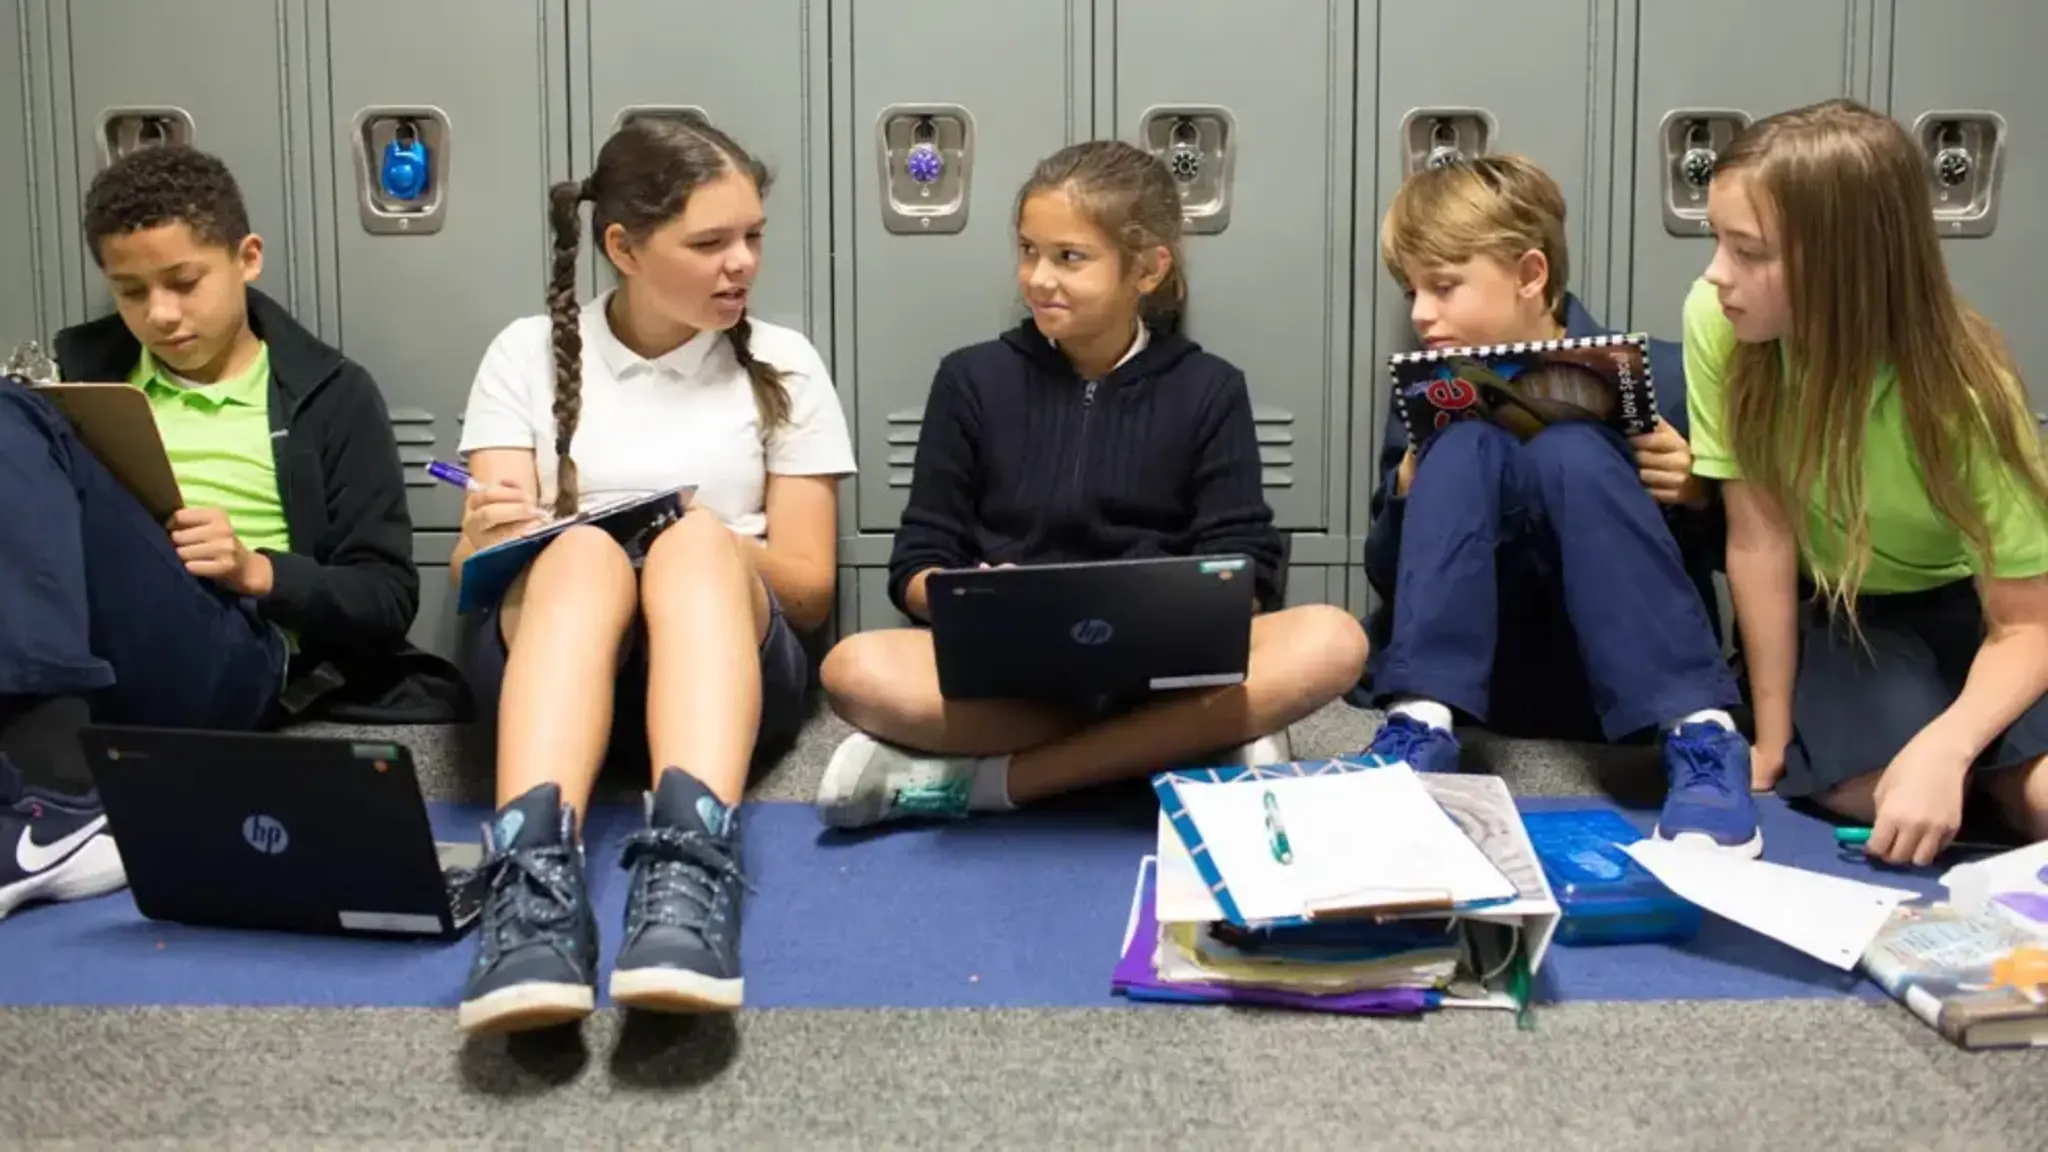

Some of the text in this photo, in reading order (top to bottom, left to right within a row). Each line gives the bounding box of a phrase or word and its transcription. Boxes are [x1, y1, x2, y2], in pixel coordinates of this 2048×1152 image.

[1621, 391, 1638, 418] love
[1074, 618, 1110, 645] hp
[247, 814, 285, 854] hp
